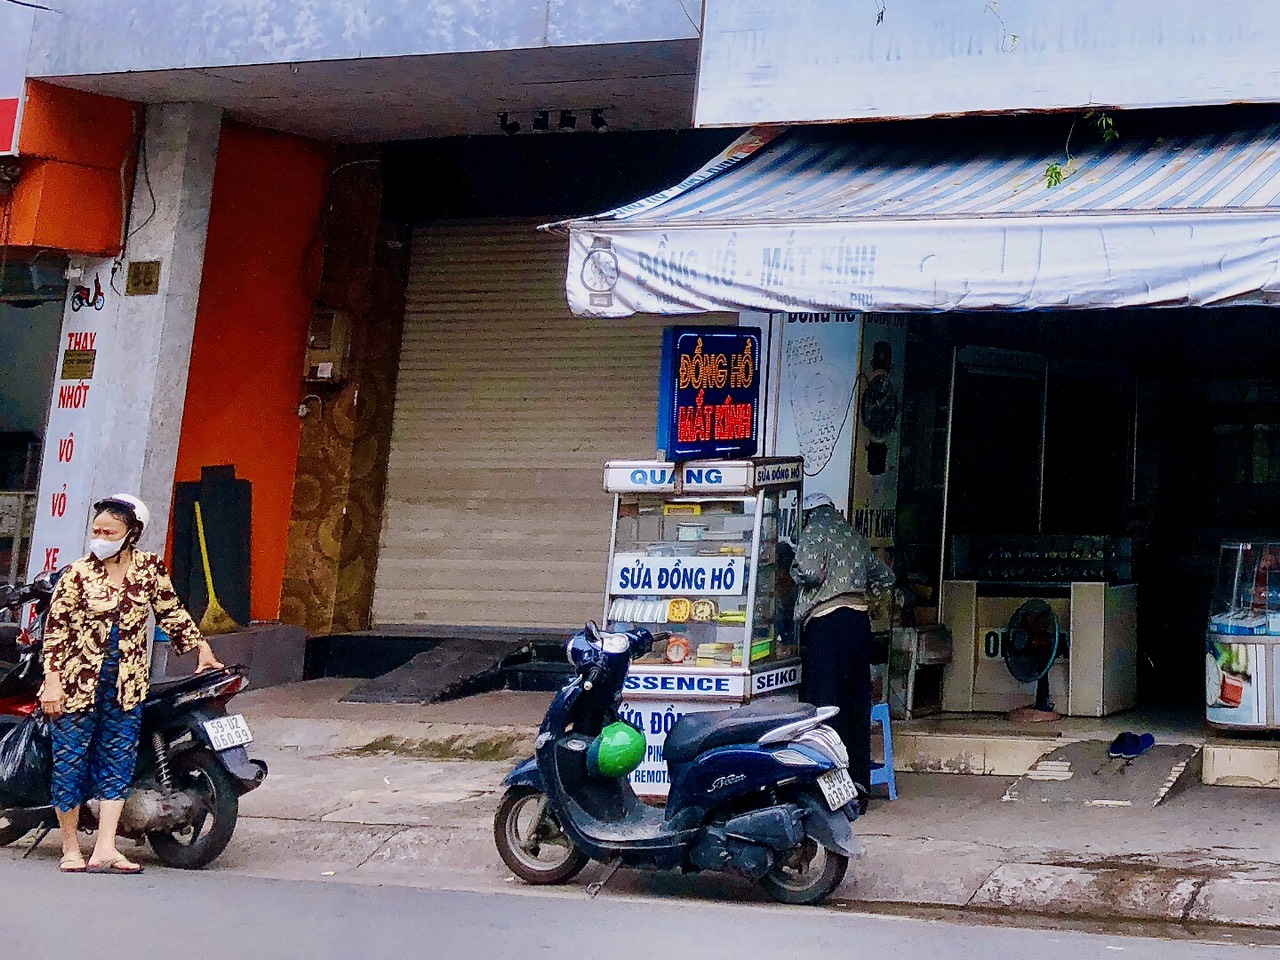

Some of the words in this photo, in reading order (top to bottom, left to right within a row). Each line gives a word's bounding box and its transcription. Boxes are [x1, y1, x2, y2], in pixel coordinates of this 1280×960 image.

[67, 332, 97, 351] THAY
[679, 337, 728, 389] ĐỒNG
[730, 338, 754, 389] HỒ
[57, 378, 90, 409] NHỚT
[677, 388, 714, 442] MẮT
[714, 394, 752, 440] KÍNH
[58, 432, 74, 463] VÔ
[756, 466, 771, 483] SỬA
[51, 483, 67, 518] VỎ
[44, 547, 60, 572] XE
[619, 559, 653, 590] SỬA
[657, 558, 706, 590] ĐỒNG
[710, 558, 735, 590] HỒ
[625, 676, 730, 692] SSENCE
[756, 668, 797, 690] SEIKO
[619, 703, 646, 731] ỬA
[650, 704, 685, 735] ĐỒ
